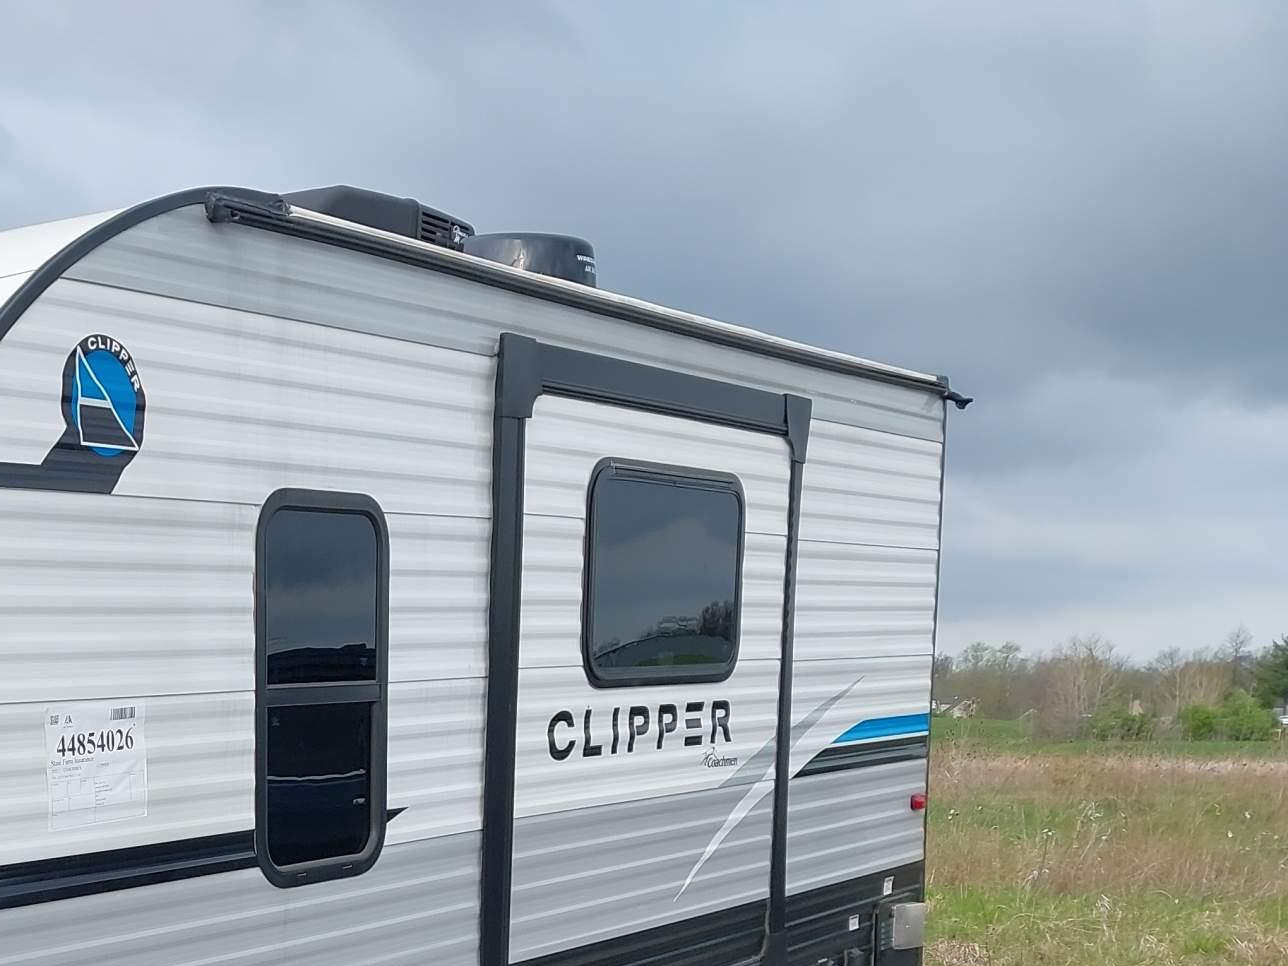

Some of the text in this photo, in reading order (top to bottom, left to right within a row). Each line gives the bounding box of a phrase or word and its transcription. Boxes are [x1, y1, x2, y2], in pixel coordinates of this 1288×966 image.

[87, 336, 141, 392] CLIPPER
[56, 727, 134, 757] 44854026
[547, 700, 732, 762] CLIPPER
[706, 754, 738, 769] Coachmen
